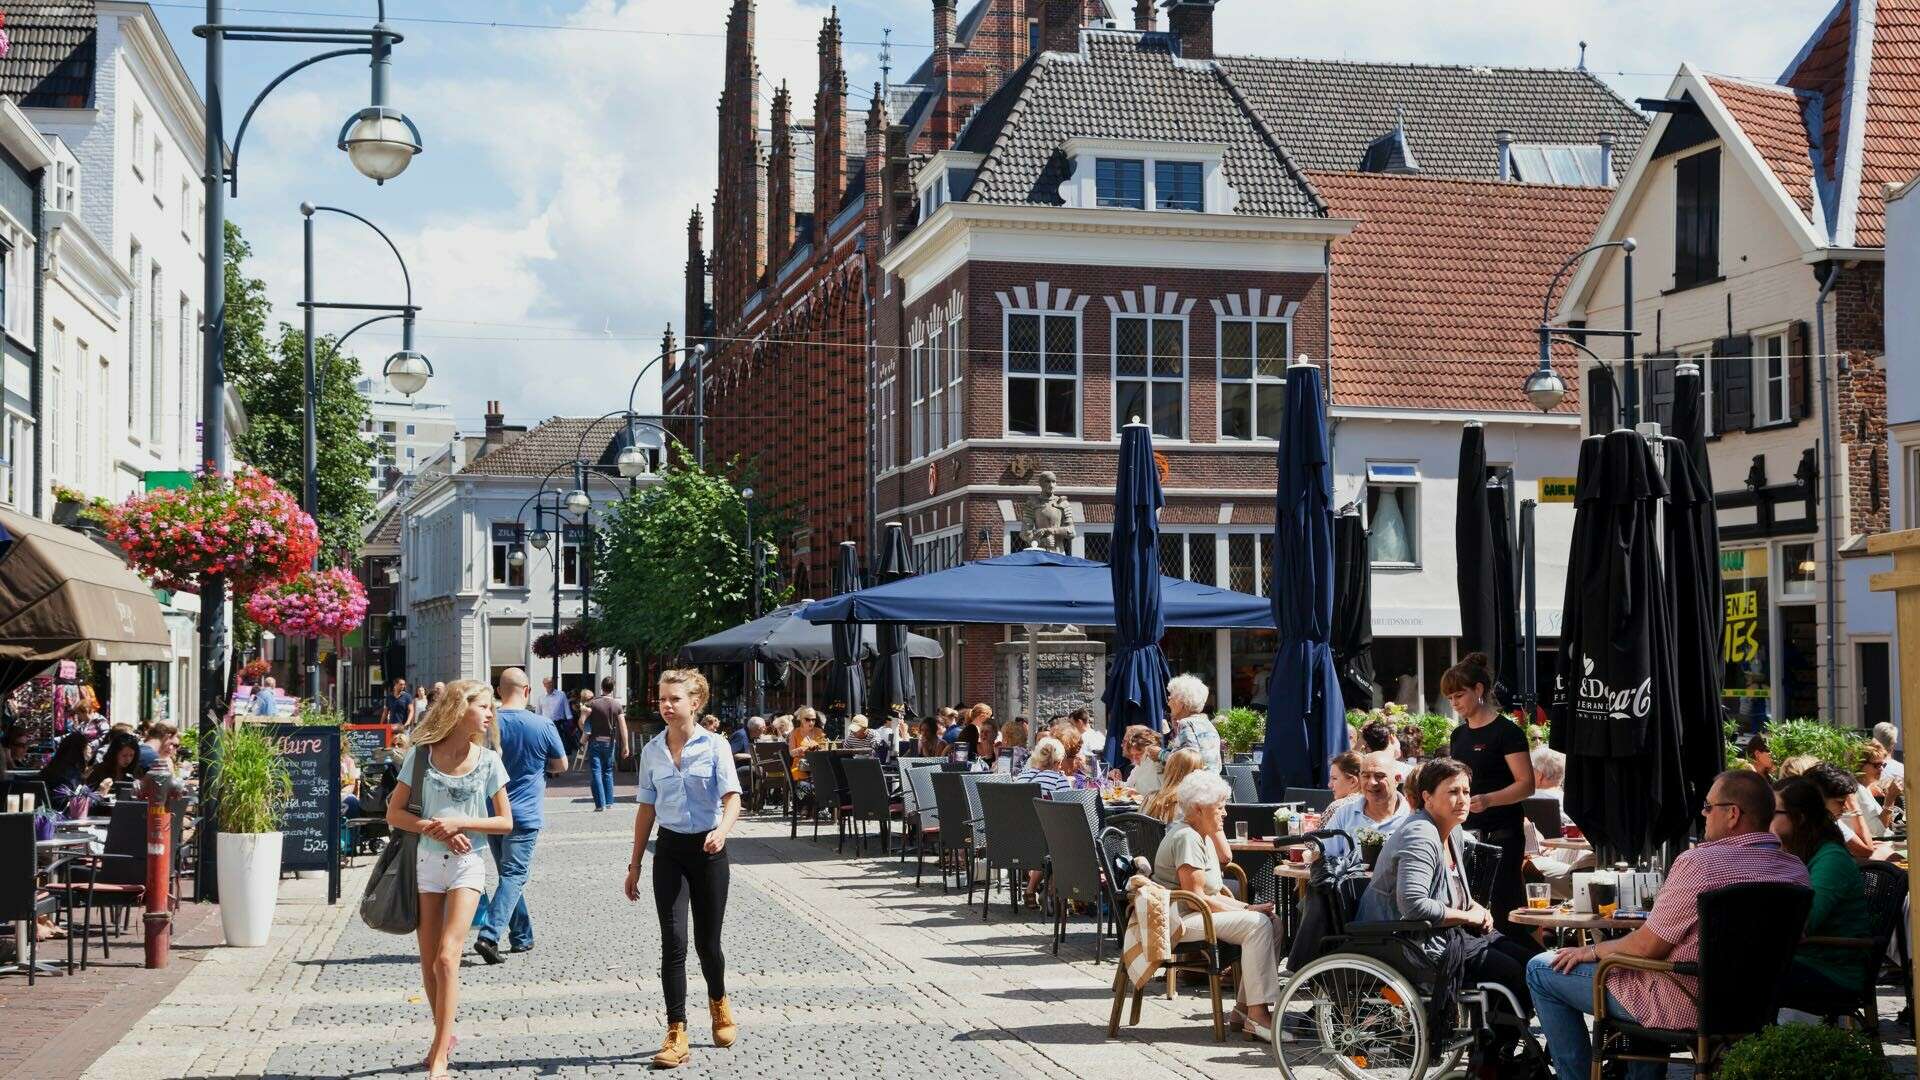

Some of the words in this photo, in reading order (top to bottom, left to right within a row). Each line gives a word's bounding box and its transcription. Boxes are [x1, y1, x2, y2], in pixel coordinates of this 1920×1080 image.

[1725, 596, 1740, 618] EN
[1742, 594, 1755, 616] JE
[1608, 676, 1652, 718] ca-C
[303, 838, 328, 853] 5,25
